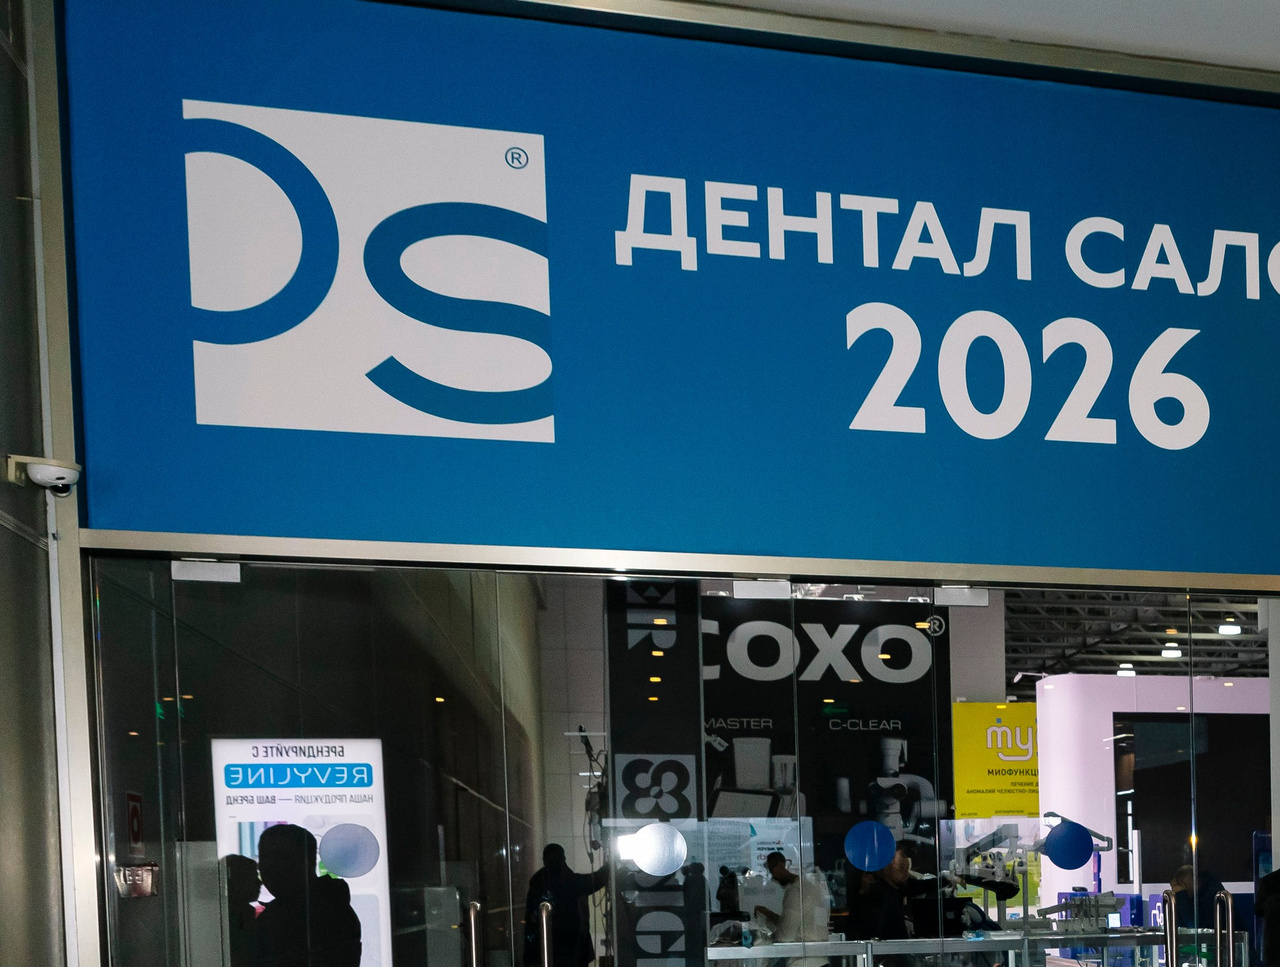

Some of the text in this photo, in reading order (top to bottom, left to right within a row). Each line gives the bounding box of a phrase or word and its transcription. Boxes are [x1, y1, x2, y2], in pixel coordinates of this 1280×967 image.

[614, 173, 1032, 282] ДЕНТАЛ
[845, 301, 1210, 450] 2026
[829, 718, 902, 731] C-CLEAR
